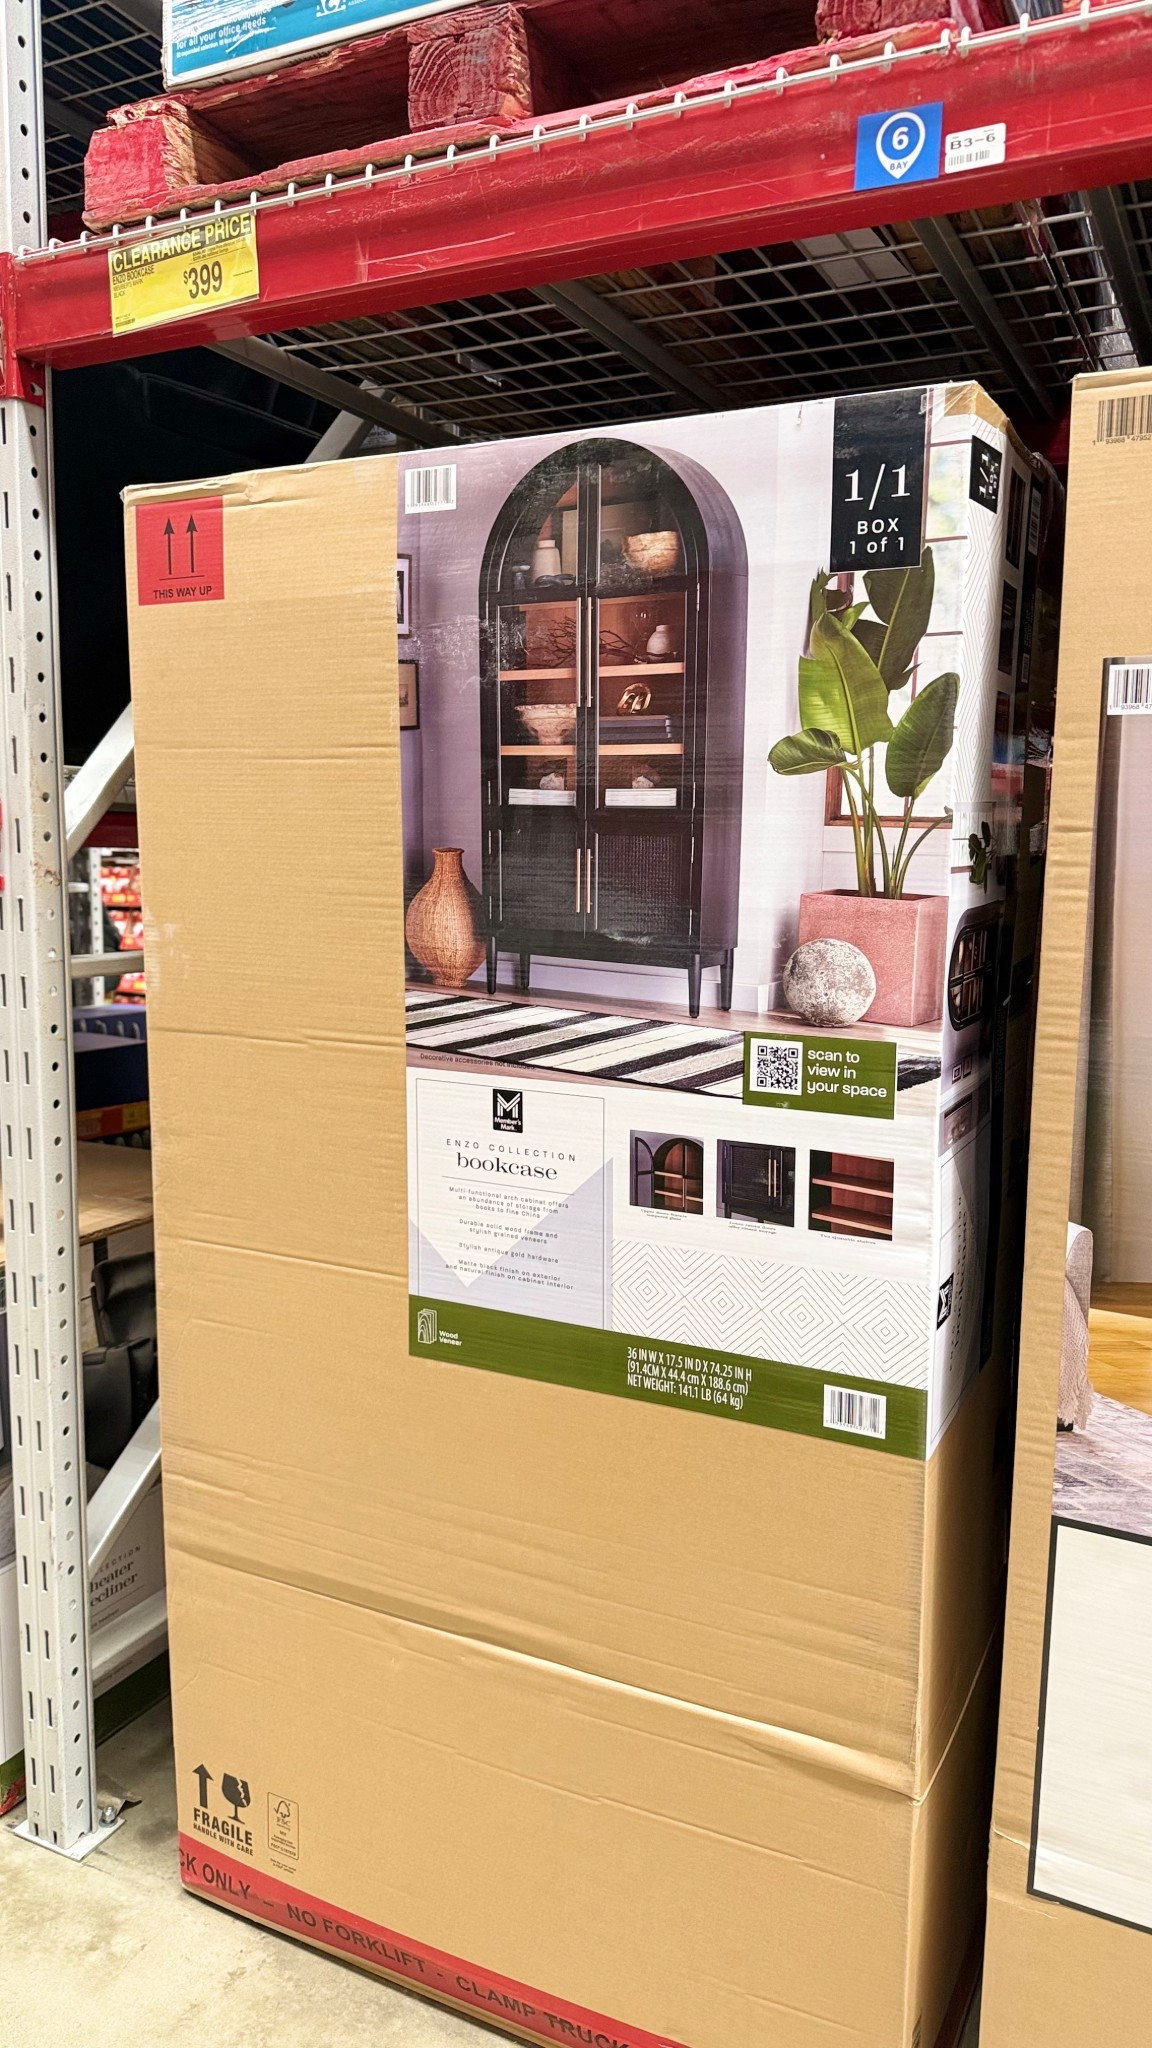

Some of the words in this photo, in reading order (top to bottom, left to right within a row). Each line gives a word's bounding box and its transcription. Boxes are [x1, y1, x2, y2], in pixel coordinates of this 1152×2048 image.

[189, 34, 198, 47] all
[200, 31, 217, 44] your
[218, 25, 241, 38] office
[892, 127, 909, 150] 6
[890, 161, 909, 171] BAY
[113, 230, 201, 272] CLEARANCE
[205, 212, 250, 245] PRICE
[112, 274, 126, 286] ENZO
[127, 264, 155, 282] BOOKCASE
[184, 260, 222, 300] $399
[844, 463, 911, 511] 1/1
[857, 517, 900, 535] BOX
[850, 540, 856, 555] 1
[866, 536, 888, 554] of
[898, 536, 904, 551] 1
[153, 588, 174, 599] THIS
[176, 586, 197, 598] WAY
[200, 585, 212, 596] UP
[420, 1052, 454, 1063] Decorative
[454, 1056, 493, 1066] accessories
[808, 1050, 842, 1062] scan
[846, 1052, 860, 1064] to
[808, 1064, 840, 1078] view
[844, 1066, 856, 1079] in
[807, 1081, 840, 1094] your
[842, 1084, 888, 1098] space
[494, 1116, 522, 1126] Member's
[446, 1138, 480, 1149] ENZO
[488, 1144, 576, 1162] COLLECTION
[456, 1152, 558, 1180] bookcase
[449, 1186, 502, 1199] Multi-functional
[504, 1194, 518, 1202] arch
[520, 1196, 546, 1206] cabinet
[548, 1200, 568, 1208] offers
[468, 1196, 504, 1206] abundance
[516, 1203, 540, 1212] storage
[542, 1206, 558, 1214] from
[476, 1204, 495, 1212] books
[506, 1208, 519, 1216] fine
[459, 1218, 484, 1227] Durable
[486, 1222, 502, 1230] solid
[524, 1228, 543, 1236] frame
[470, 1227, 492, 1236] stylish
[494, 1231, 518, 1240] grained
[521, 1236, 547, 1244] veneers
[458, 1242, 482, 1251] Stylish
[484, 1246, 508, 1255] antique
[510, 1250, 525, 1258] gold
[528, 1253, 559, 1264] hardware
[458, 1260, 477, 1268] Matte
[480, 1262, 498, 1270] black
[500, 1266, 520, 1274] finish
[532, 1272, 560, 1282] exterior
[460, 1266, 484, 1274] natural
[485, 1270, 506, 1278] finish
[518, 1276, 544, 1286] cabinet
[546, 1280, 574, 1290] interior
[439, 1330, 458, 1339] Wood
[439, 1336, 462, 1346] Veneer
[627, 1346, 638, 1360] 36
[638, 1348, 648, 1362] IN
[648, 1350, 658, 1362] W
[658, 1352, 664, 1364] X
[666, 1354, 682, 1368] 17.5
[684, 1356, 694, 1370] IN
[696, 1358, 702, 1372] D
[702, 1360, 708, 1374] X
[710, 1362, 732, 1378] 74.25
[734, 1366, 744, 1380] IN
[746, 1368, 752, 1382] H
[627, 1359, 660, 1378] (91.4CM
[660, 1366, 666, 1378] X
[668, 1368, 686, 1382] 44.4
[687, 1372, 700, 1386] cm
[700, 1374, 706, 1386] X
[708, 1375, 731, 1392] 188.6
[732, 1382, 749, 1396] cm)
[627, 1374, 642, 1388] NET
[644, 1376, 677, 1394] WEIGHT:
[678, 1384, 699, 1398] 141.1
[701, 1388, 712, 1402] LB
[713, 1390, 728, 1404] (64
[730, 1393, 744, 1410] kg)
[100, 1546, 141, 1573] LECTION
[90, 1560, 134, 1593] heater
[90, 1572, 138, 1607] ecliner
[193, 1806, 253, 1847] FRAGILE
[193, 1822, 217, 1839] HANDLE
[218, 1834, 234, 1848] WITH
[236, 1842, 254, 1856] CARE
[202, 1863, 251, 1900] ONLY
[286, 1904, 316, 1928] NO
[322, 1918, 426, 1974] FORKLIFT
[456, 1975, 536, 2017] CLAMP
